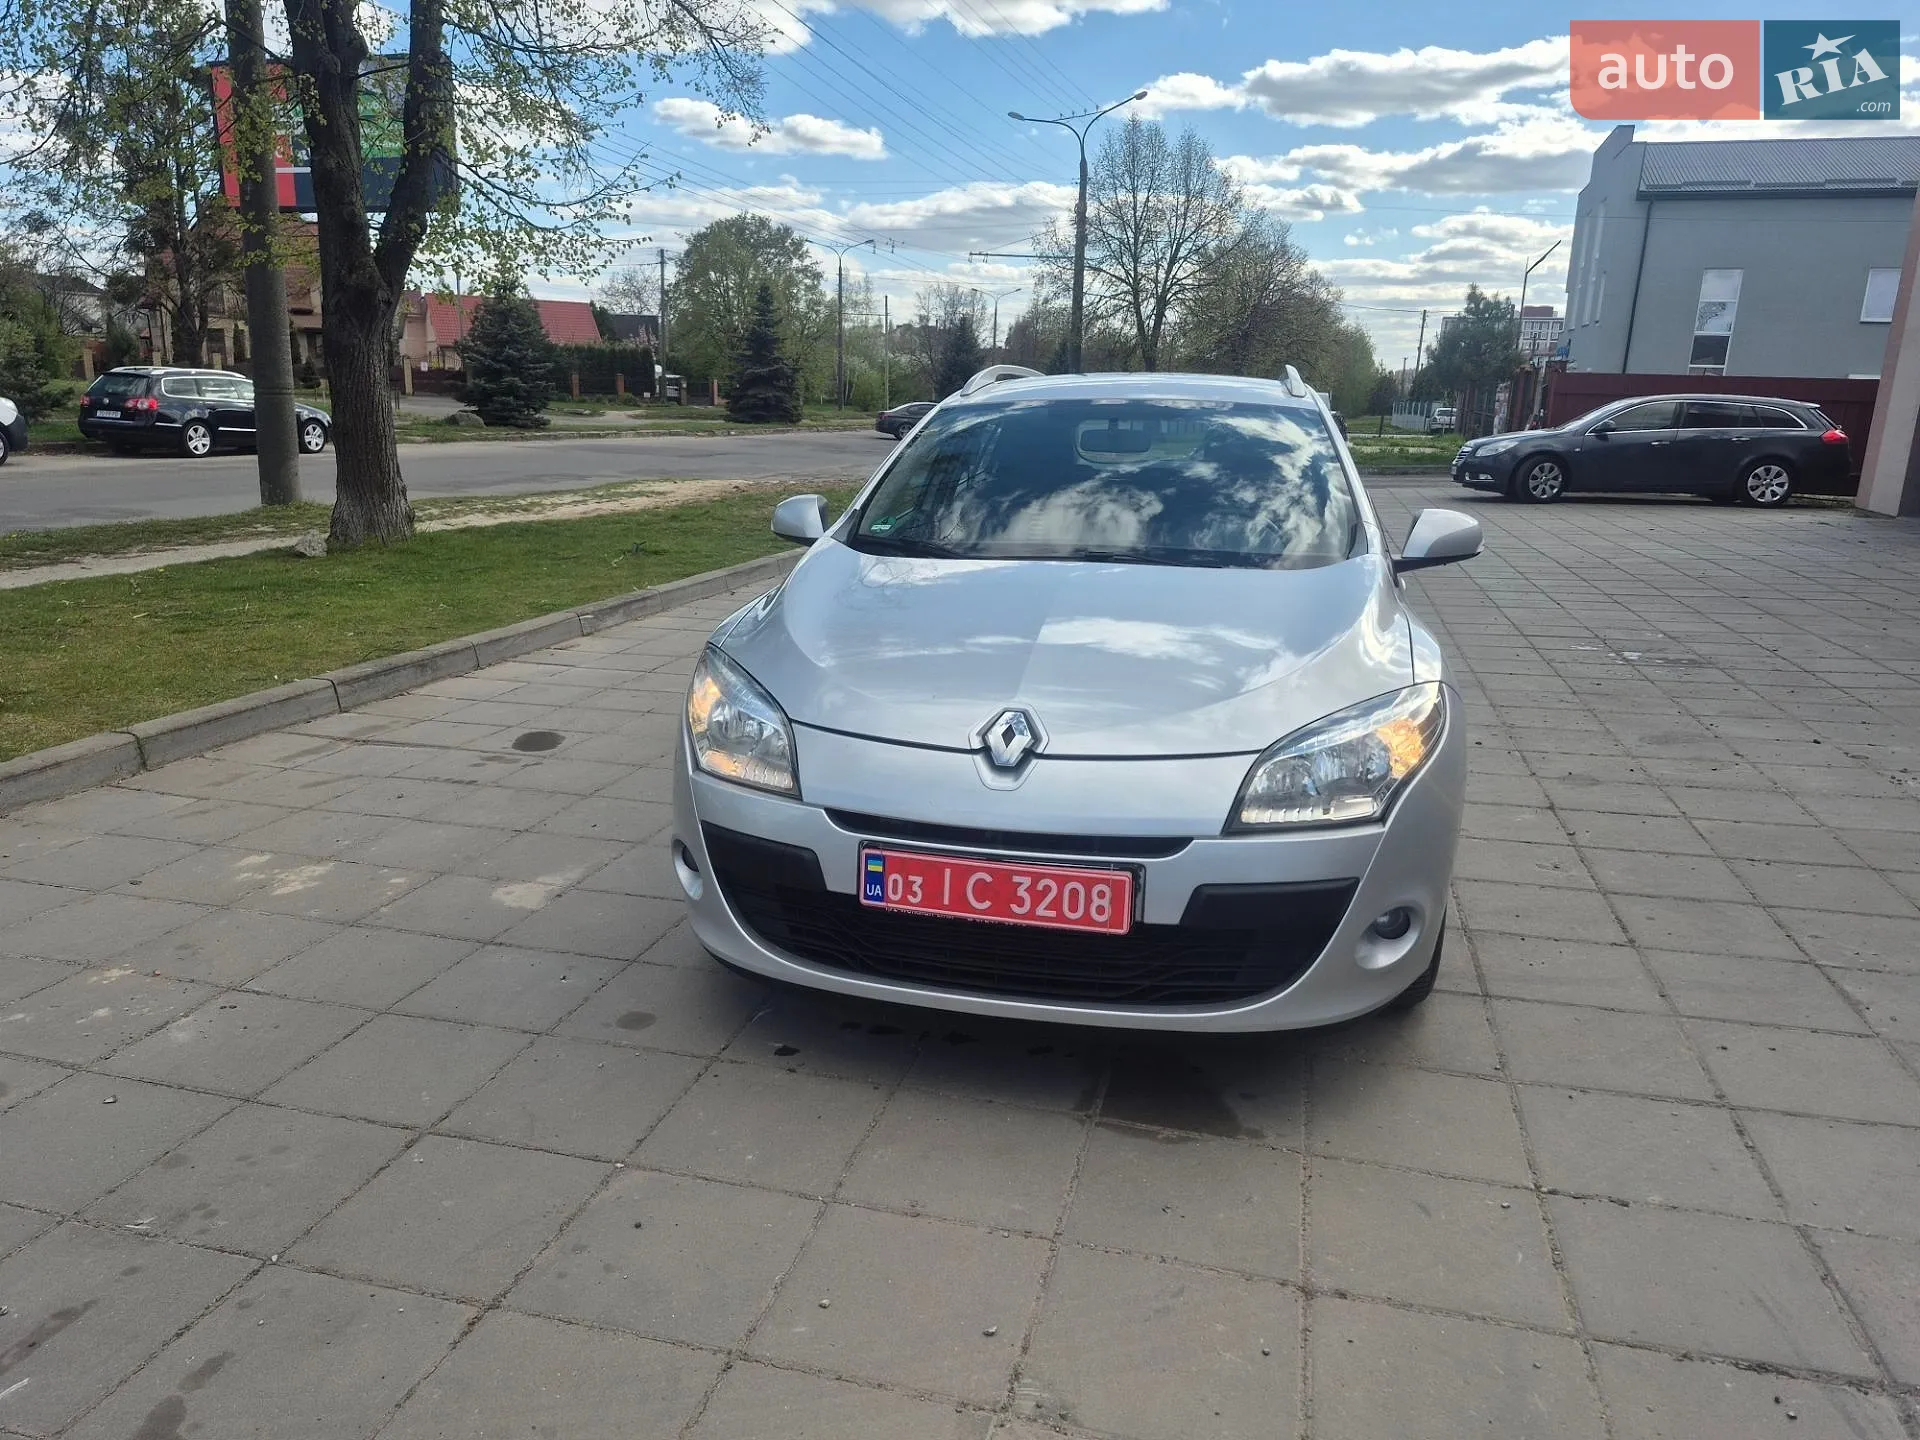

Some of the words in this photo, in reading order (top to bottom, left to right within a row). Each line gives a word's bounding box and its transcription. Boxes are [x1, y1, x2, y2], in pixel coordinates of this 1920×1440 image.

[866, 883, 882, 897] UA
[887, 873, 923, 904] 03
[1009, 875, 1112, 922] 3208
